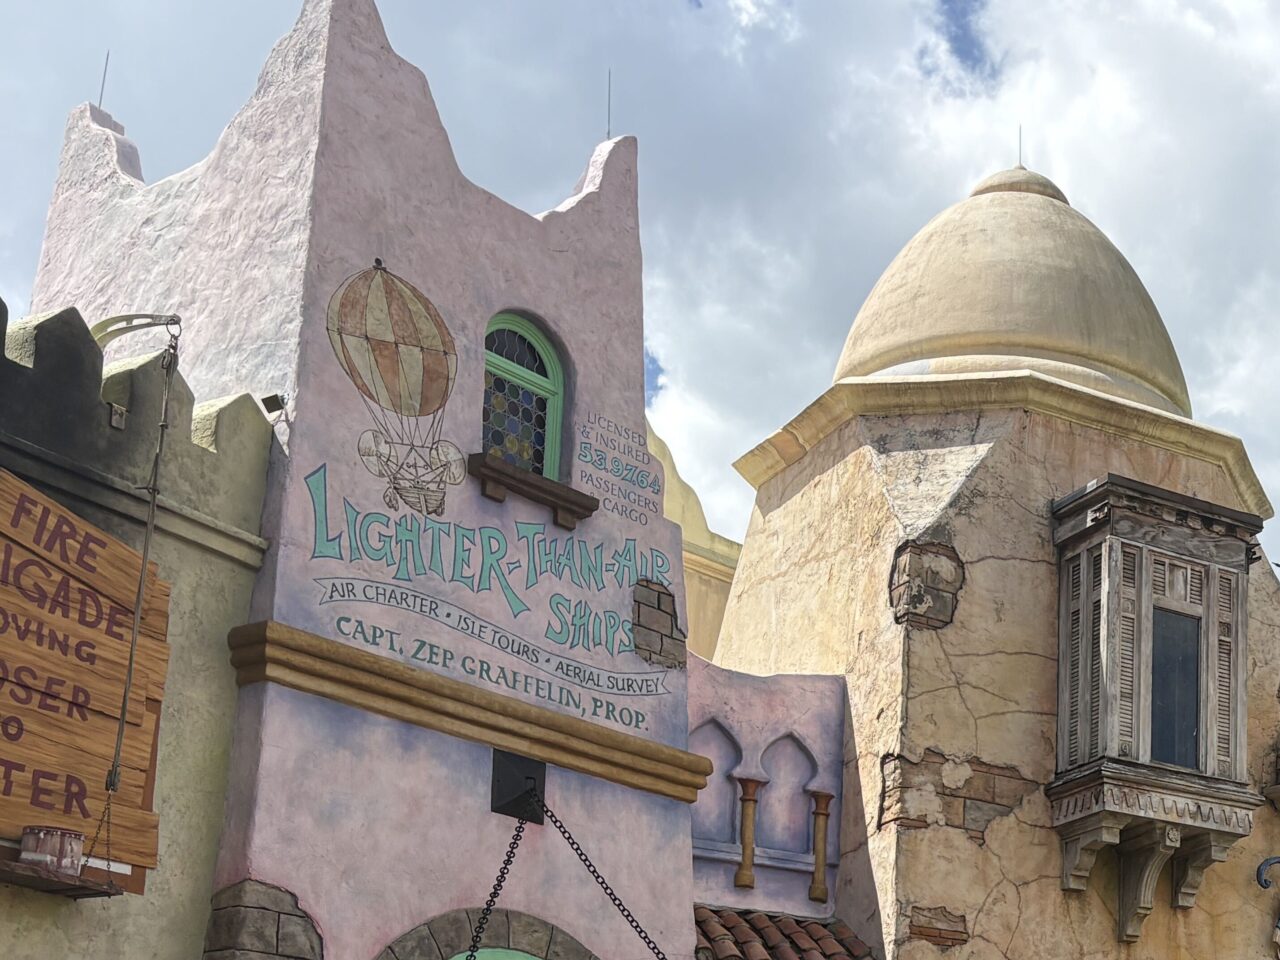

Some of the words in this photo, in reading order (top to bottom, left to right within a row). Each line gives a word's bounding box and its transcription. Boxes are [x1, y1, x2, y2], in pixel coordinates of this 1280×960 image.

[581, 425, 590, 440] &
[595, 432, 650, 465] INSURED
[588, 411, 647, 447] LICENSED
[580, 470, 659, 514] PASSENGERS
[603, 498, 648, 526] CARGO
[10, 493, 108, 574] FIRE
[329, 582, 357, 600] AIR
[363, 585, 440, 618] CHARTER
[457, 614, 488, 640] ISLE
[491, 629, 540, 664] TOURS
[555, 660, 604, 688] AERIAL
[606, 675, 660, 694] SURVEY
[545, 593, 636, 656] SHIPS
[0, 663, 91, 722] SER
[336, 616, 404, 655] CAPT.
[411, 639, 454, 669] ZEP
[461, 655, 587, 717] GRAFFELIN,
[591, 697, 650, 731] PROP.
